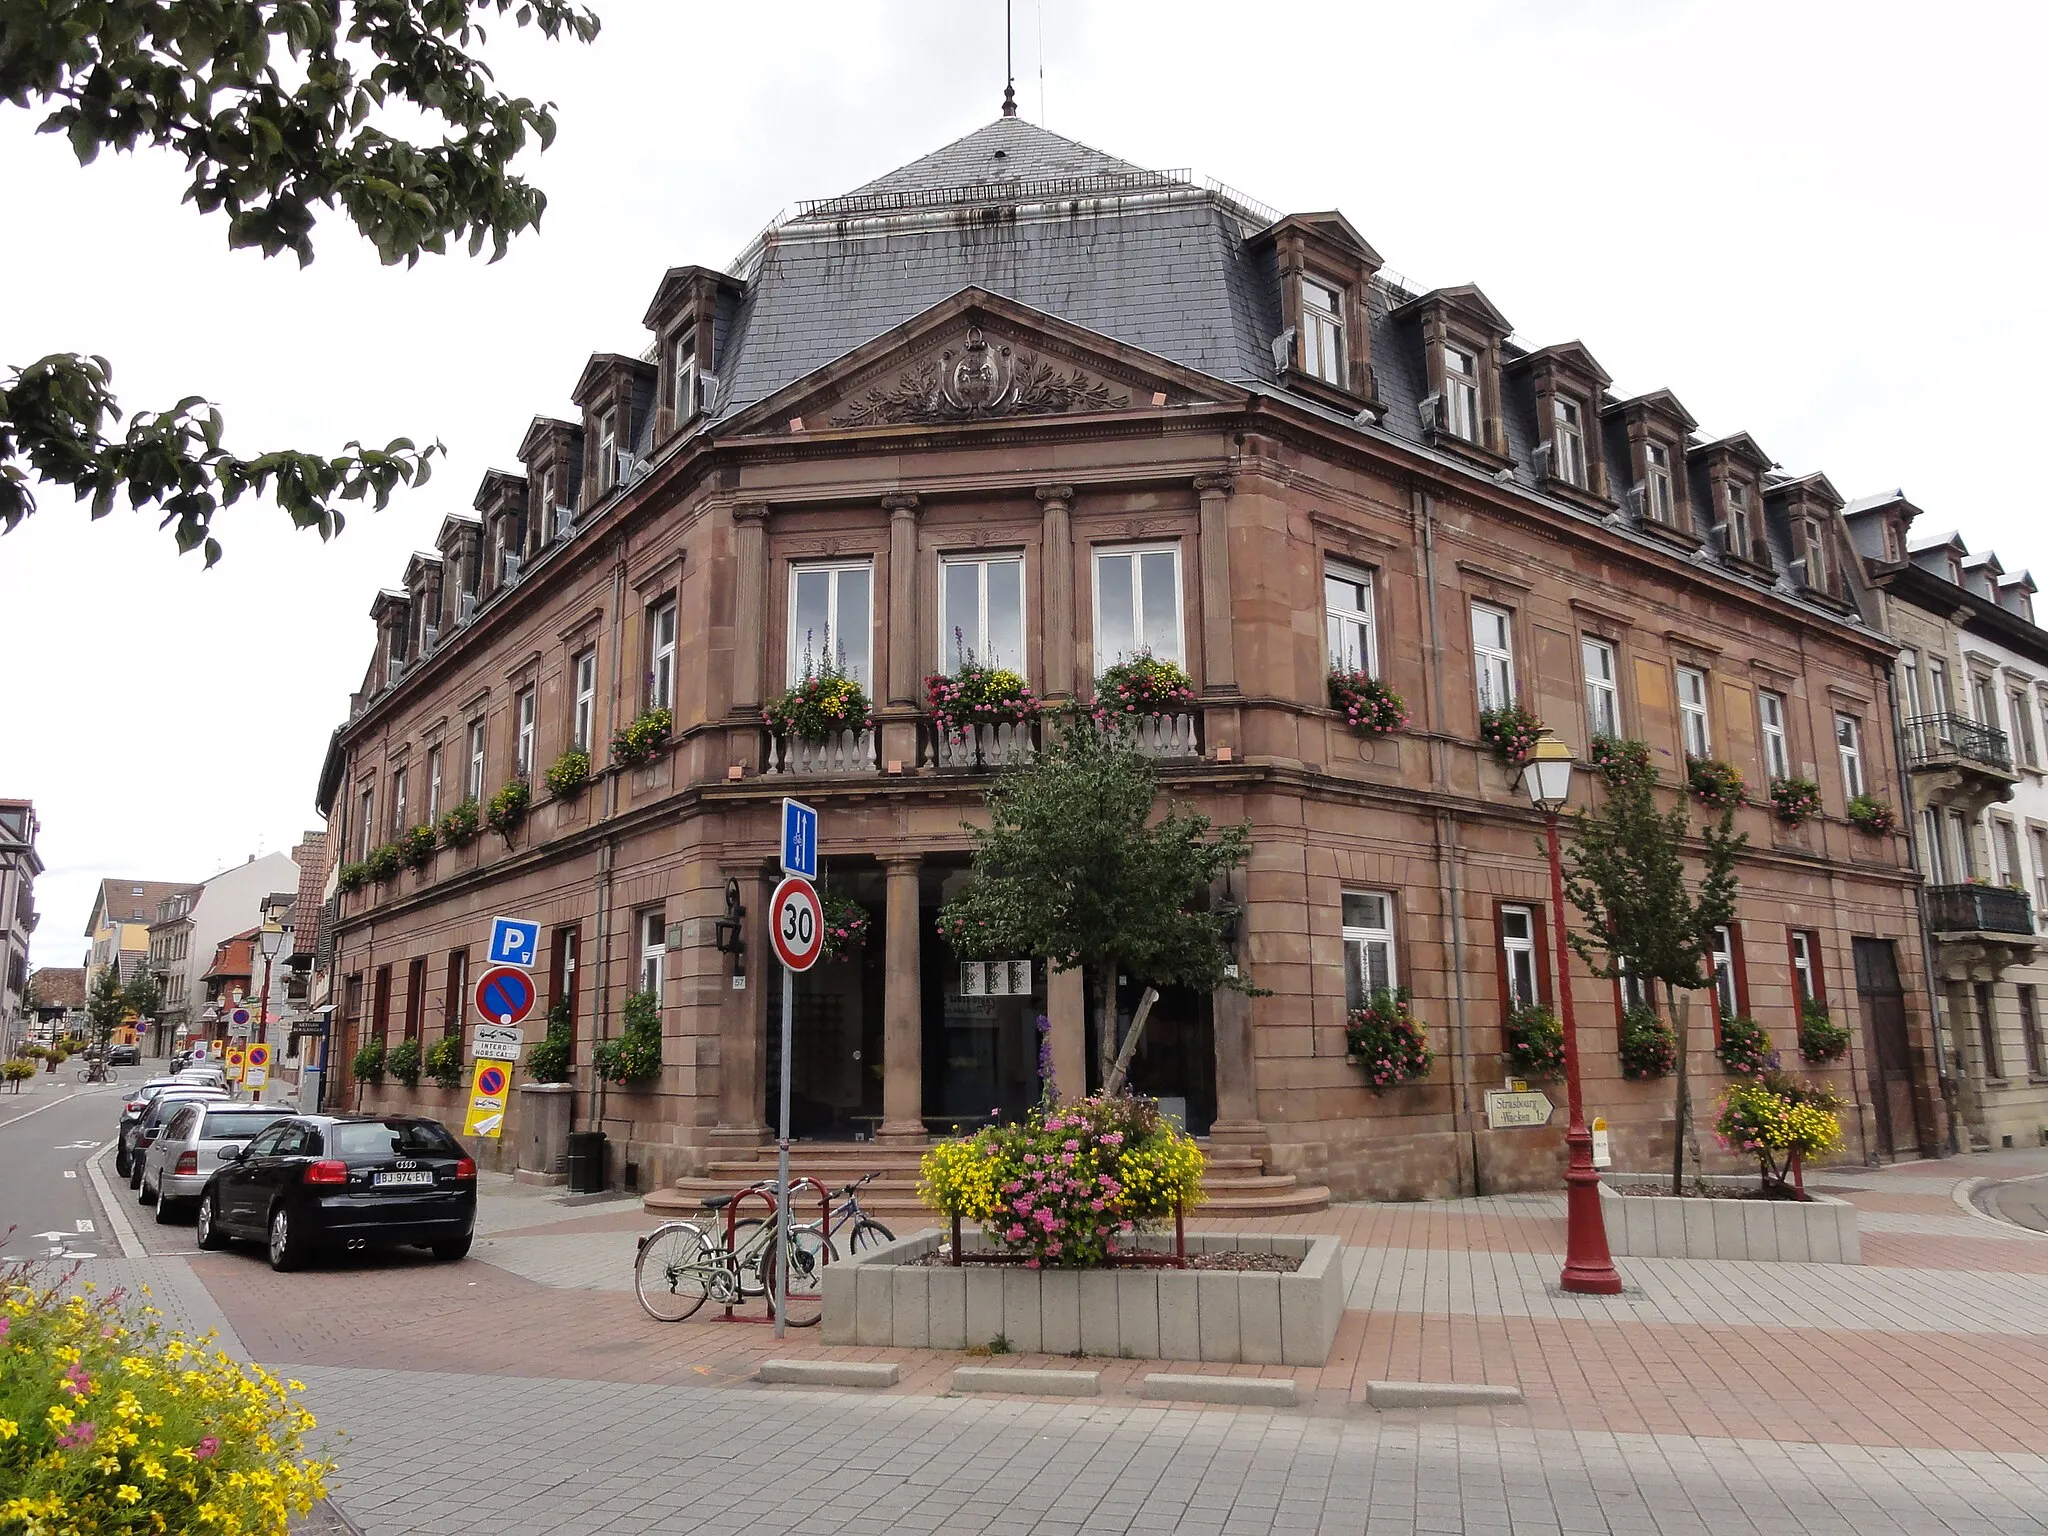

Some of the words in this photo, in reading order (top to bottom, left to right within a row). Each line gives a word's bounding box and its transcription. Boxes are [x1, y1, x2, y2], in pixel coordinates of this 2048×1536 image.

[783, 903, 812, 943] 30
[503, 928, 524, 955] P
[1496, 1096, 1537, 1109] Strasbourg
